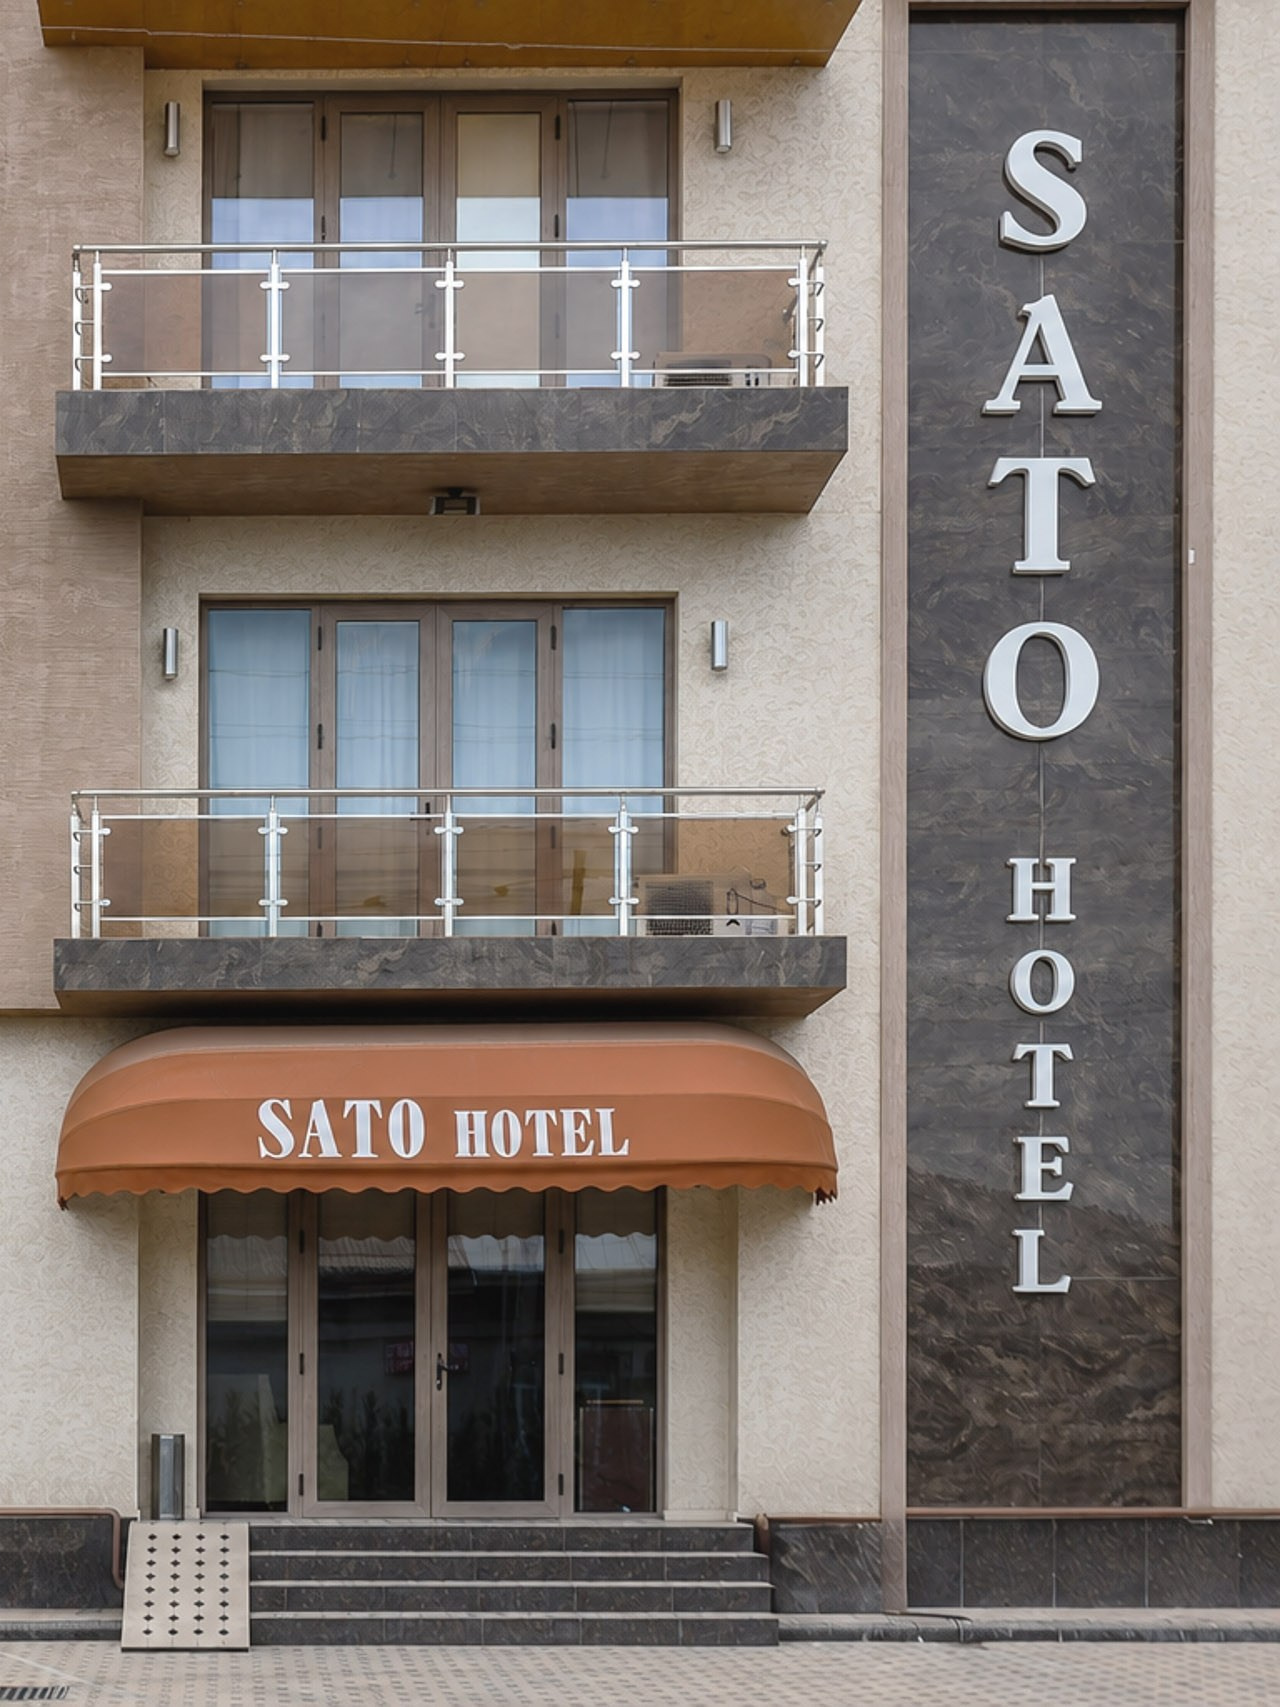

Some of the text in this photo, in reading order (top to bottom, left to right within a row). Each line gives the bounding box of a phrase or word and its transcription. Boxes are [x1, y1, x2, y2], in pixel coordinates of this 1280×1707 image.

[983, 130, 1103, 1294] SATO HOTEL
[257, 1098, 630, 1159] SATO HOTEL
